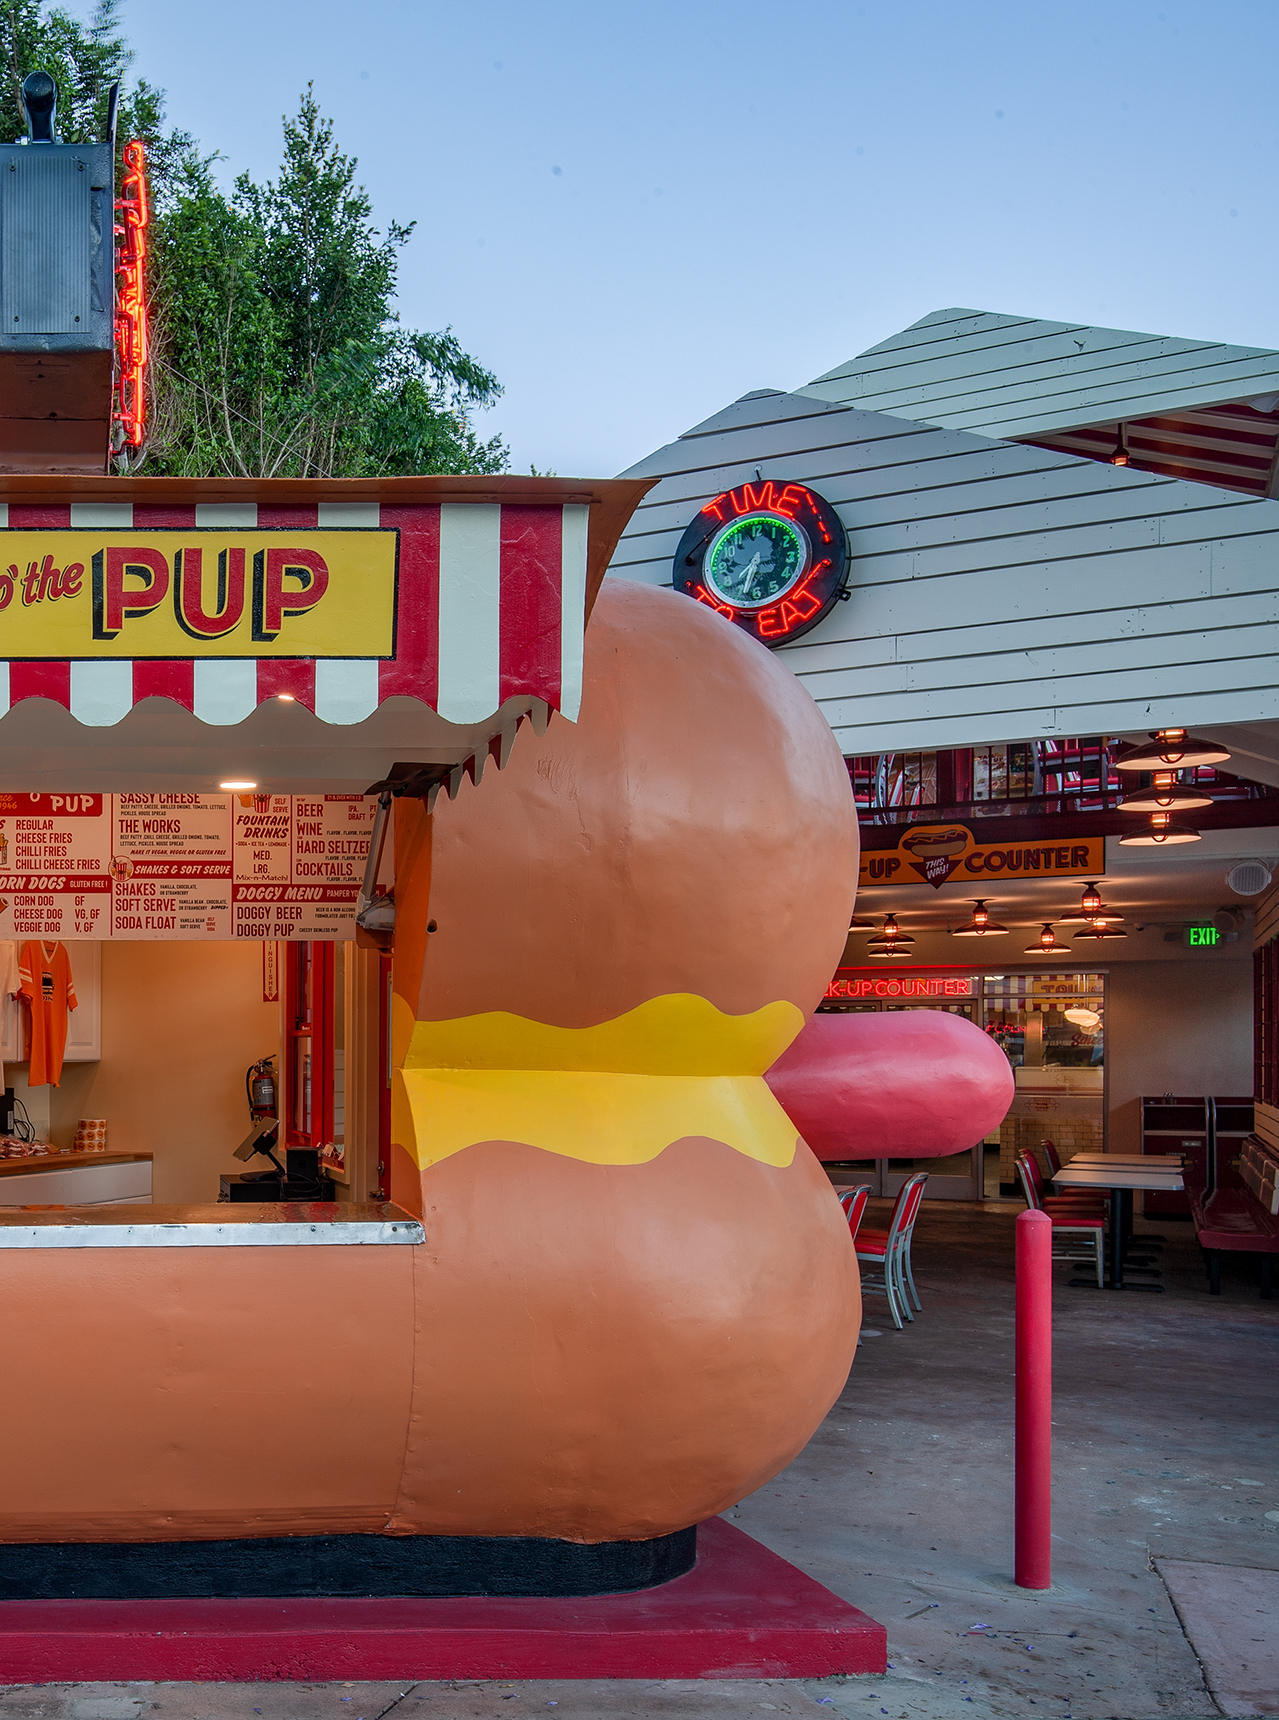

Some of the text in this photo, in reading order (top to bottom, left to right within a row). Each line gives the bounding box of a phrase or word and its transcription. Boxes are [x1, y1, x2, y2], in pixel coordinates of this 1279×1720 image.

[701, 481, 807, 521] TIME
[751, 524, 762, 537] 12
[772, 527, 776, 539] 1
[734, 533, 742, 545] 11
[782, 535, 790, 547] 2
[723, 546, 735, 558] 10
[786, 552, 795, 563] 3
[780, 566, 790, 578] 4
[723, 575, 732, 587] 8
[770, 581, 778, 593] 5
[92, 546, 330, 642] PUP
[752, 588, 761, 599] 6
[50, 794, 94, 812] PUP
[120, 793, 200, 804] SASSY CHEESE
[297, 804, 324, 817] BEER
[236, 815, 290, 826] FOUNTAIN
[348, 813, 366, 821] DRAFT
[16, 820, 54, 830] REGULAR
[119, 819, 181, 833] THE WORKS
[297, 822, 323, 836] WINE
[16, 832, 73, 844] CHEESE FRIES
[243, 827, 289, 839] DRINKS
[16, 846, 67, 857] CHILLI FRIES
[297, 840, 325, 854] HARD
[253, 850, 273, 860] MED.
[964, 845, 1090, 873] COUNTER
[16, 859, 101, 870] CHILLI CHEESE FRIES
[253, 864, 270, 874] LRG.
[296, 862, 353, 876] COCKTAILS
[925, 857, 945, 870] THIS
[134, 865, 169, 875] SHAKES
[180, 865, 202, 875] SOFT
[203, 865, 231, 875] SERVE
[926, 864, 949, 880] WAY!
[28, 876, 66, 890] DOGS
[69, 880, 91, 888] GLUTEN
[92, 880, 105, 888] FREE
[115, 883, 156, 896] SHAKES
[236, 887, 350, 900] DOGGY MENU PAMPER
[14, 895, 85, 906] CORN DOG GF
[115, 899, 176, 912] SOFT SERVE
[14, 908, 46, 919] CHEESE
[47, 908, 63, 919] DOG
[90, 908, 101, 919] GF
[236, 906, 303, 920] DOGGY BEER
[14, 922, 43, 933] VEGGIE
[44, 922, 61, 933] DOG
[83, 922, 94, 933] GF
[115, 916, 177, 930] SODA FLOAT
[236, 923, 271, 937] DOGGY
[274, 923, 295, 937] PUP
[1190, 927, 1217, 946] EXIT
